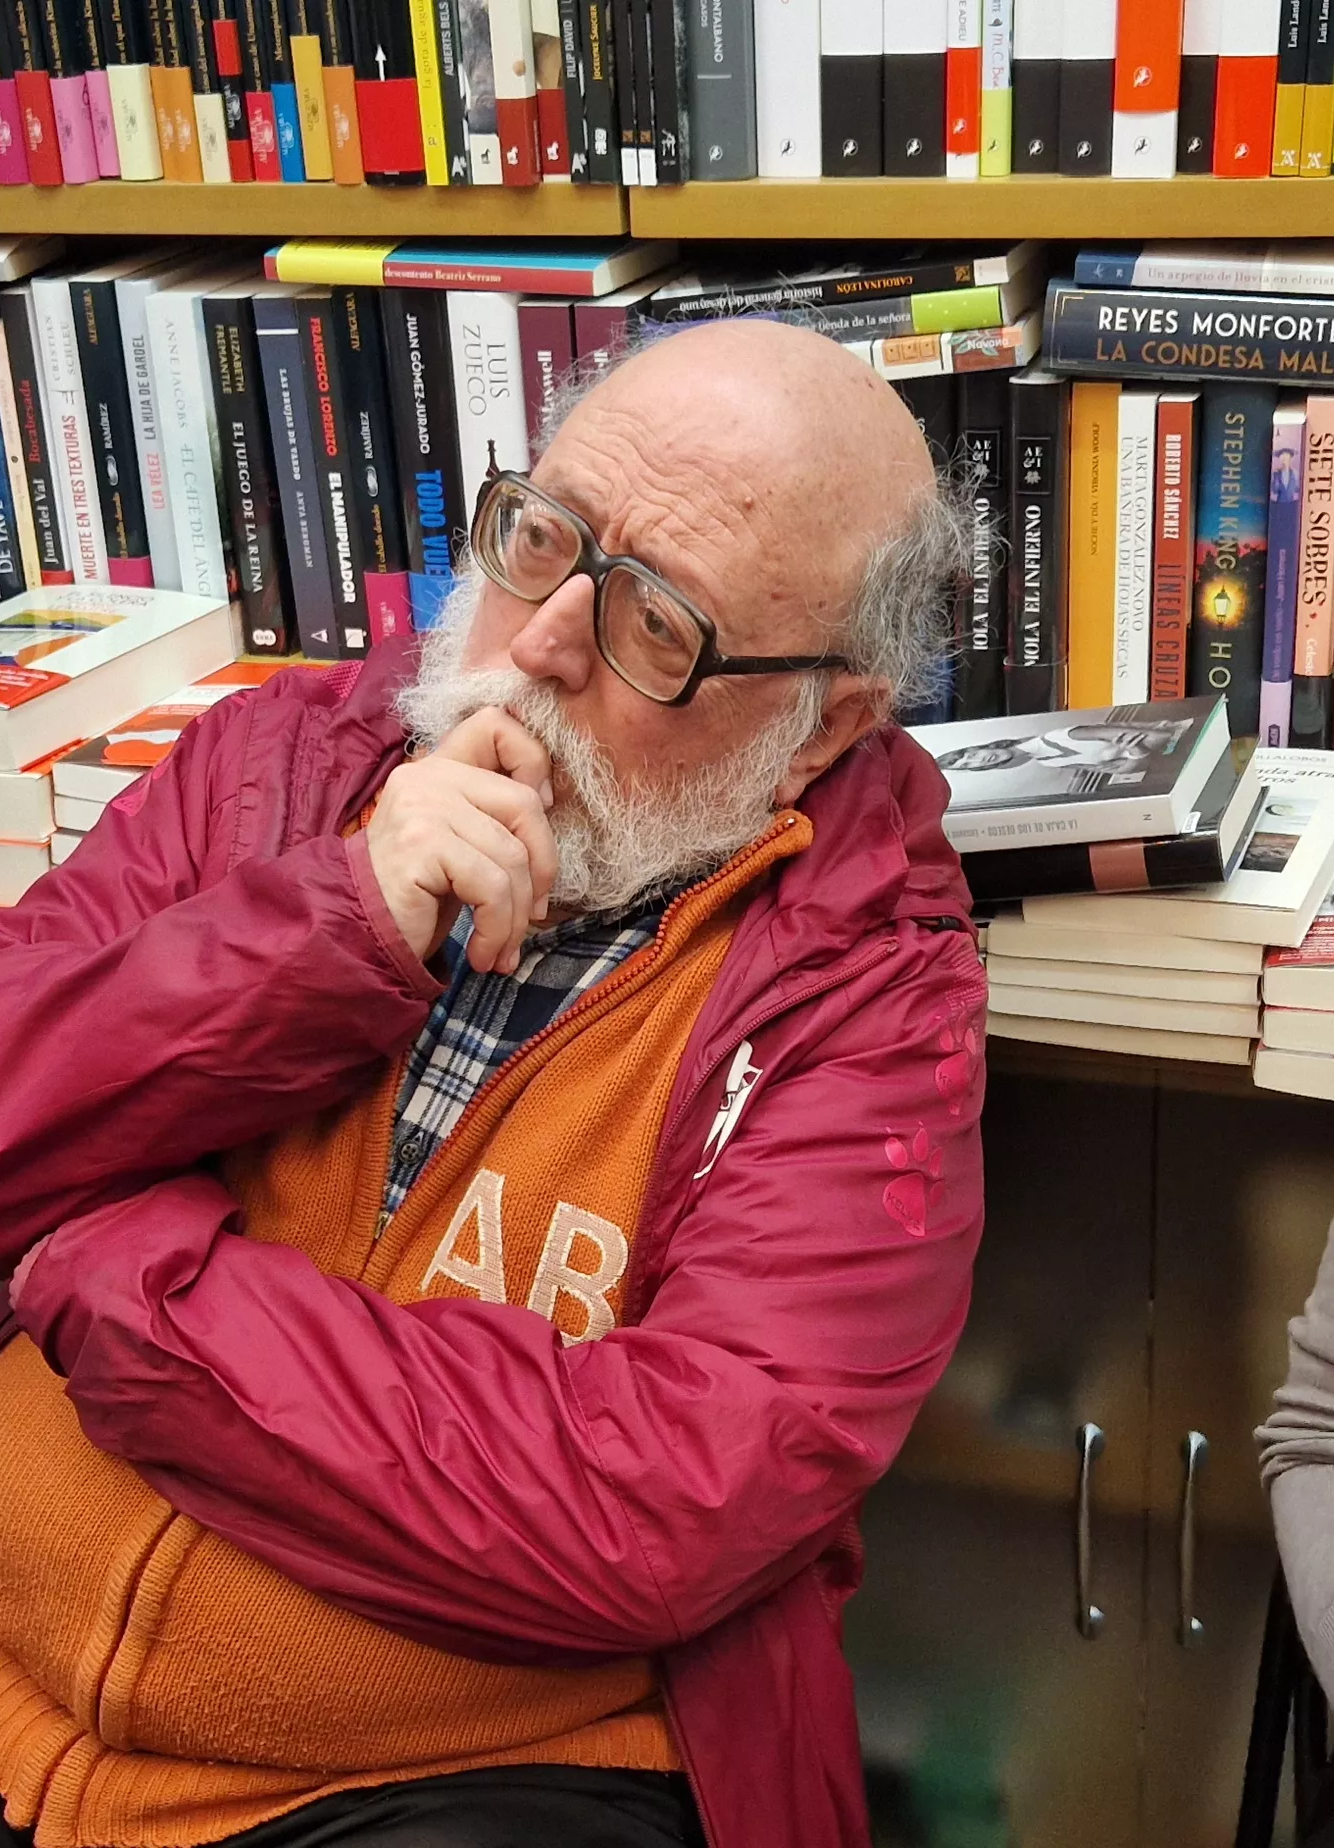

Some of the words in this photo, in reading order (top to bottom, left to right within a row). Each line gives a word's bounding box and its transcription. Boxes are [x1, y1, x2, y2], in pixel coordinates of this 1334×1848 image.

[438, 2, 450, 30] BELS
[563, 20, 574, 52] DAVID
[441, 33, 454, 76] ALBERTS
[567, 53, 577, 78] FILIP
[384, 269, 434, 281] descontento
[435, 270, 466, 282] Beatriz
[466, 272, 502, 284] Serrano
[836, 282, 864, 295] LEÓN
[865, 275, 915, 290] CAROLINA
[1147, 268, 1165, 280] Un
[1167, 271, 1213, 285] arpegio
[1216, 271, 1231, 282] de
[1233, 270, 1269, 284] lluvia
[1272, 275, 1287, 285] en
[1291, 273, 1303, 285] el
[406, 314, 421, 349] JUAN
[819, 317, 851, 331] tienda
[852, 315, 866, 328] de
[866, 314, 878, 327] la
[878, 312, 911, 325] señora
[1098, 306, 1179, 335] REYES
[215, 324, 232, 395] FREMANTLE
[227, 326, 245, 393] ELIZABETH
[310, 317, 329, 393] FRANCISCO
[462, 323, 487, 417] ZUECO
[487, 343, 510, 399] LUIS
[1096, 338, 1128, 362] LA
[1141, 341, 1265, 371] CONDESA
[19, 379, 41, 463] Bocabesada
[98, 402, 115, 449] RAMÍREZ
[319, 396, 338, 457] LORENZO
[410, 352, 432, 455] GÓMEZ-JURADO
[63, 414, 84, 477] TEXTURAS
[232, 421, 244, 440] EL
[359, 412, 375, 459] RAMÍREZ
[232, 441, 251, 494] JUEGO
[328, 472, 342, 491] EL
[1137, 436, 1149, 495] MARTA
[1164, 433, 1182, 485] ROBERTO
[1220, 412, 1245, 509] STEPHEN
[33, 478, 46, 503] Val
[70, 478, 88, 510] TRES
[242, 497, 255, 522] DE
[415, 469, 448, 528] TODO
[35, 504, 51, 528] del
[75, 510, 91, 529] EN
[244, 522, 257, 544] LA
[1163, 488, 1180, 540] SÁNCHEZ
[39, 529, 60, 564] Juan
[78, 531, 98, 581] MUERTE
[331, 491, 357, 604] MANIPULADOR
[422, 534, 451, 577] VUE
[1024, 504, 1042, 586] INFIERNO
[1133, 496, 1148, 585] GONZÁLEZ
[1216, 516, 1241, 570] KING
[1302, 510, 1331, 608] SOBRES
[249, 548, 264, 594] REINA
[1024, 588, 1040, 613] EL
[1132, 587, 1144, 632] NOVO
[420, 1168, 630, 1348] AB
